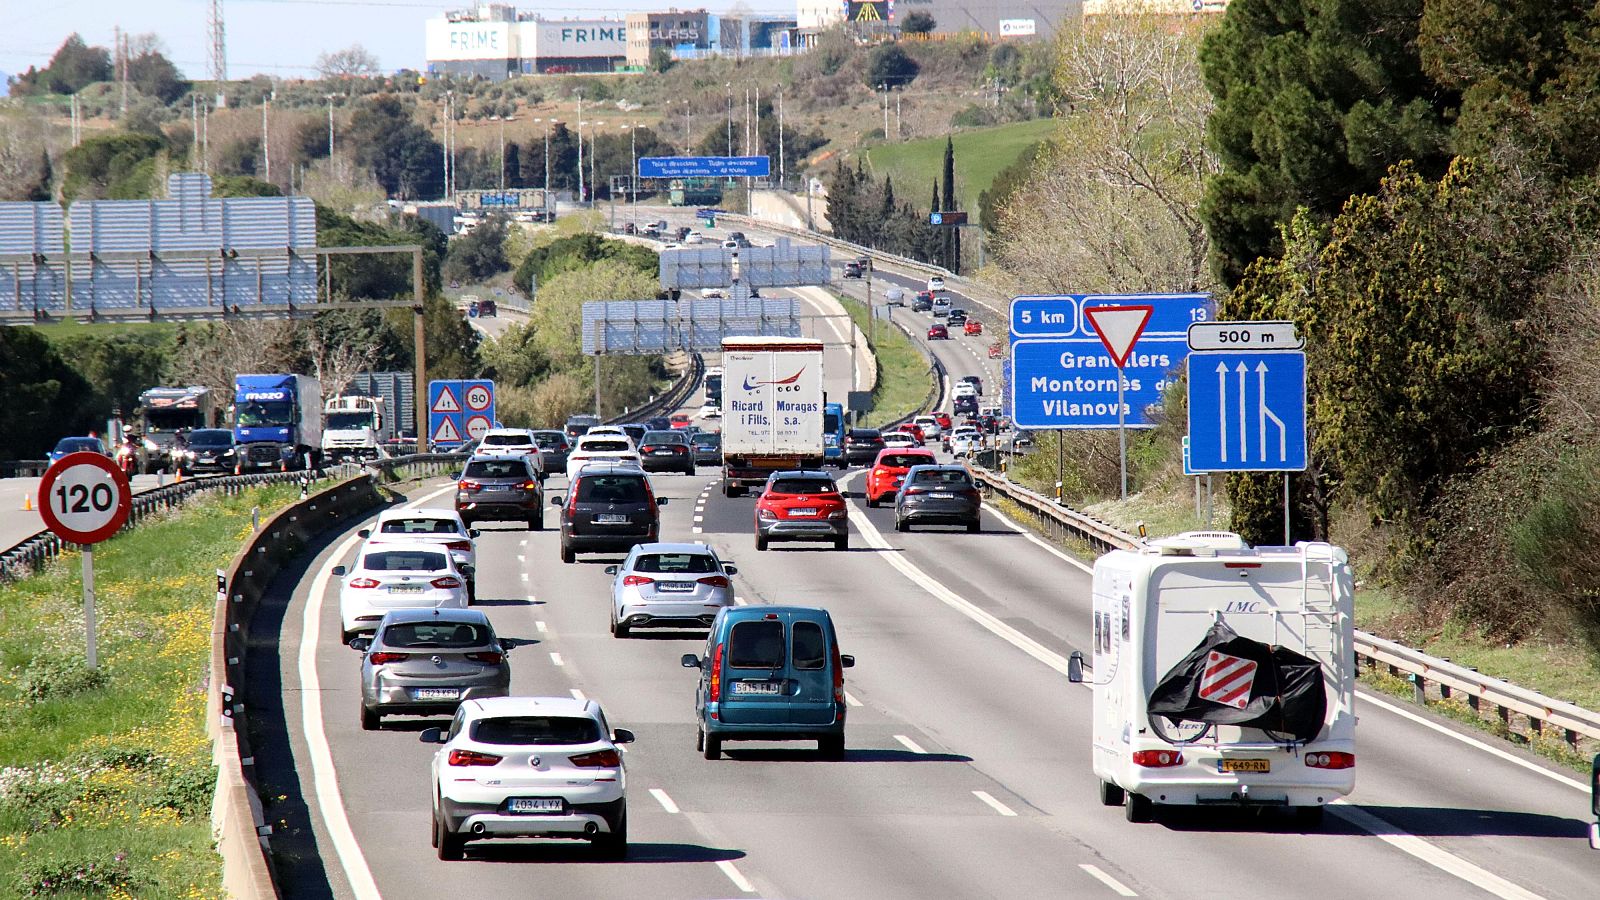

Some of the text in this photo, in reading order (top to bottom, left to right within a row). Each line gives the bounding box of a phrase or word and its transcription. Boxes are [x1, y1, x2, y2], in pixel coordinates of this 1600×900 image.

[450, 31, 498, 50] FRIME
[561, 27, 626, 43] FRIME
[648, 29, 699, 40] GLASS
[1021, 310, 1065, 324] 5 km
[1189, 308, 1207, 321] 13
[1219, 330, 1274, 343] 500 m
[1060, 352, 1170, 369] Granlers
[1031, 375, 1141, 392] Montornès
[245, 392, 284, 400] mazo
[471, 394, 486, 403] 80
[731, 400, 818, 414] Ricard Moragas
[1043, 400, 1131, 416] Vilanova
[741, 414, 801, 426] i Fills, s.a.
[56, 482, 113, 514] 120
[1225, 601, 1261, 612] LMC
[1224, 761, 1266, 770] T-649-RN
[515, 800, 561, 809] 4034 LYX
